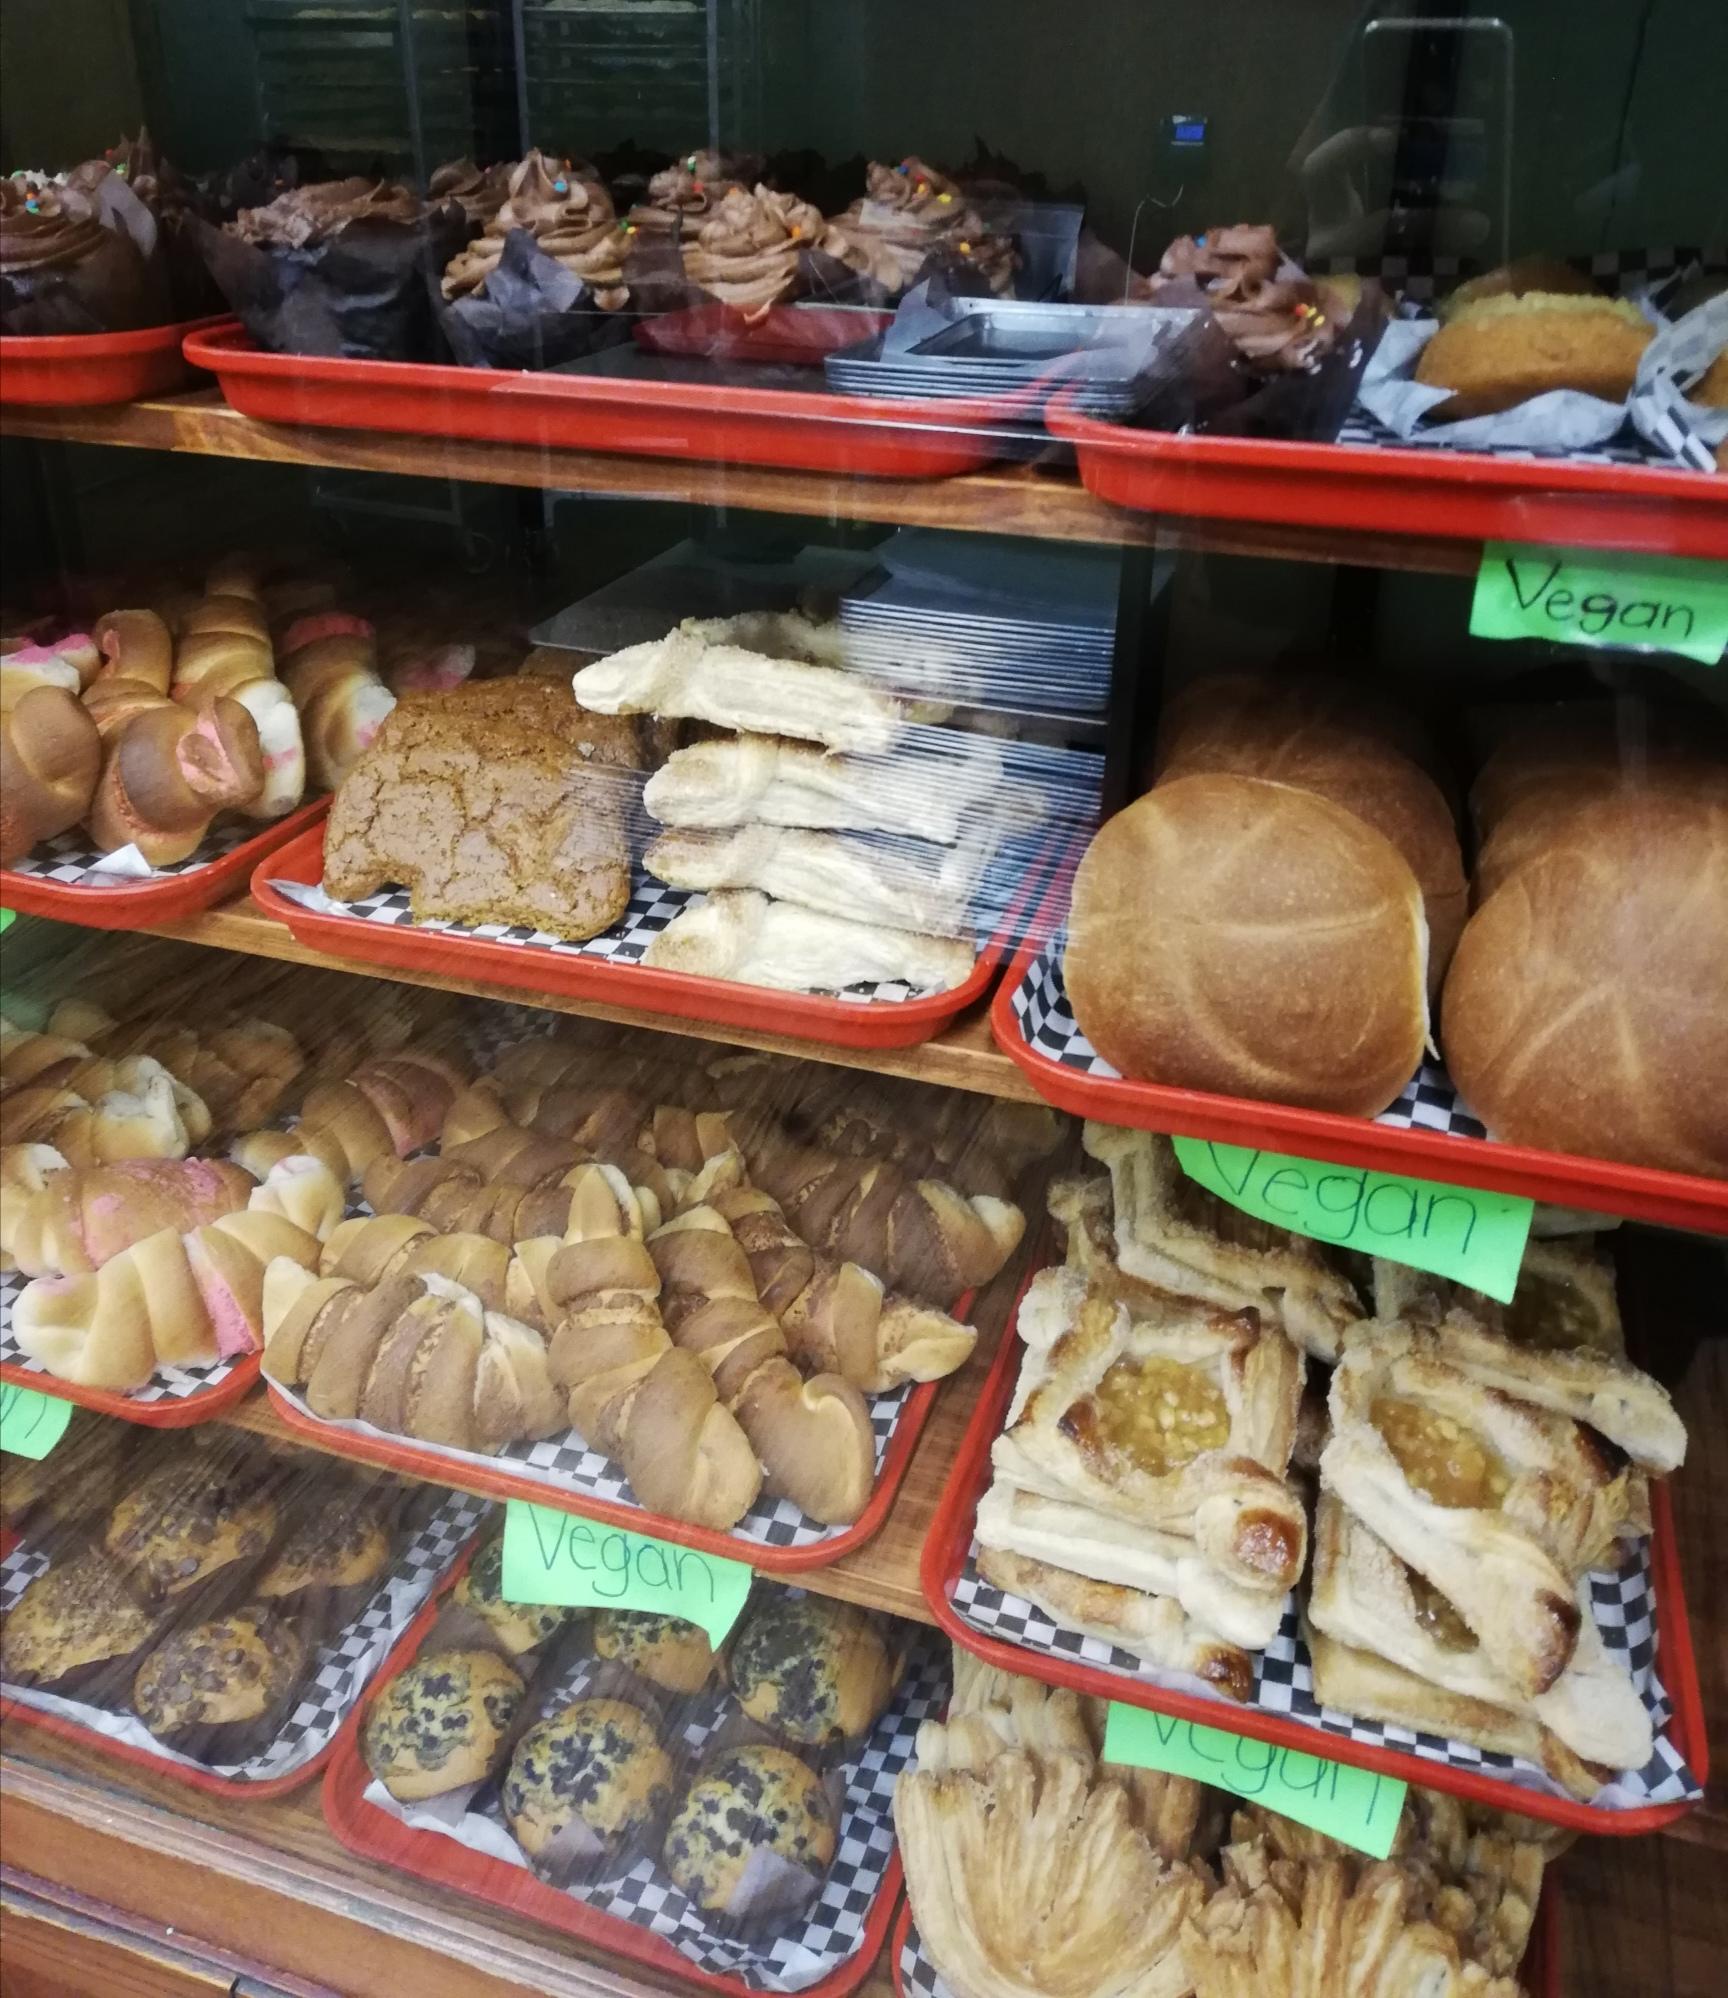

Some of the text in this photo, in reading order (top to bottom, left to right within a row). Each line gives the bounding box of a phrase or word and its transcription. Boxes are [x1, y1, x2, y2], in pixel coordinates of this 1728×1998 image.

[1505, 558, 1695, 638] Vegan
[1206, 1140, 1477, 1255] Vegan
[527, 1503, 715, 1603] Vegan
